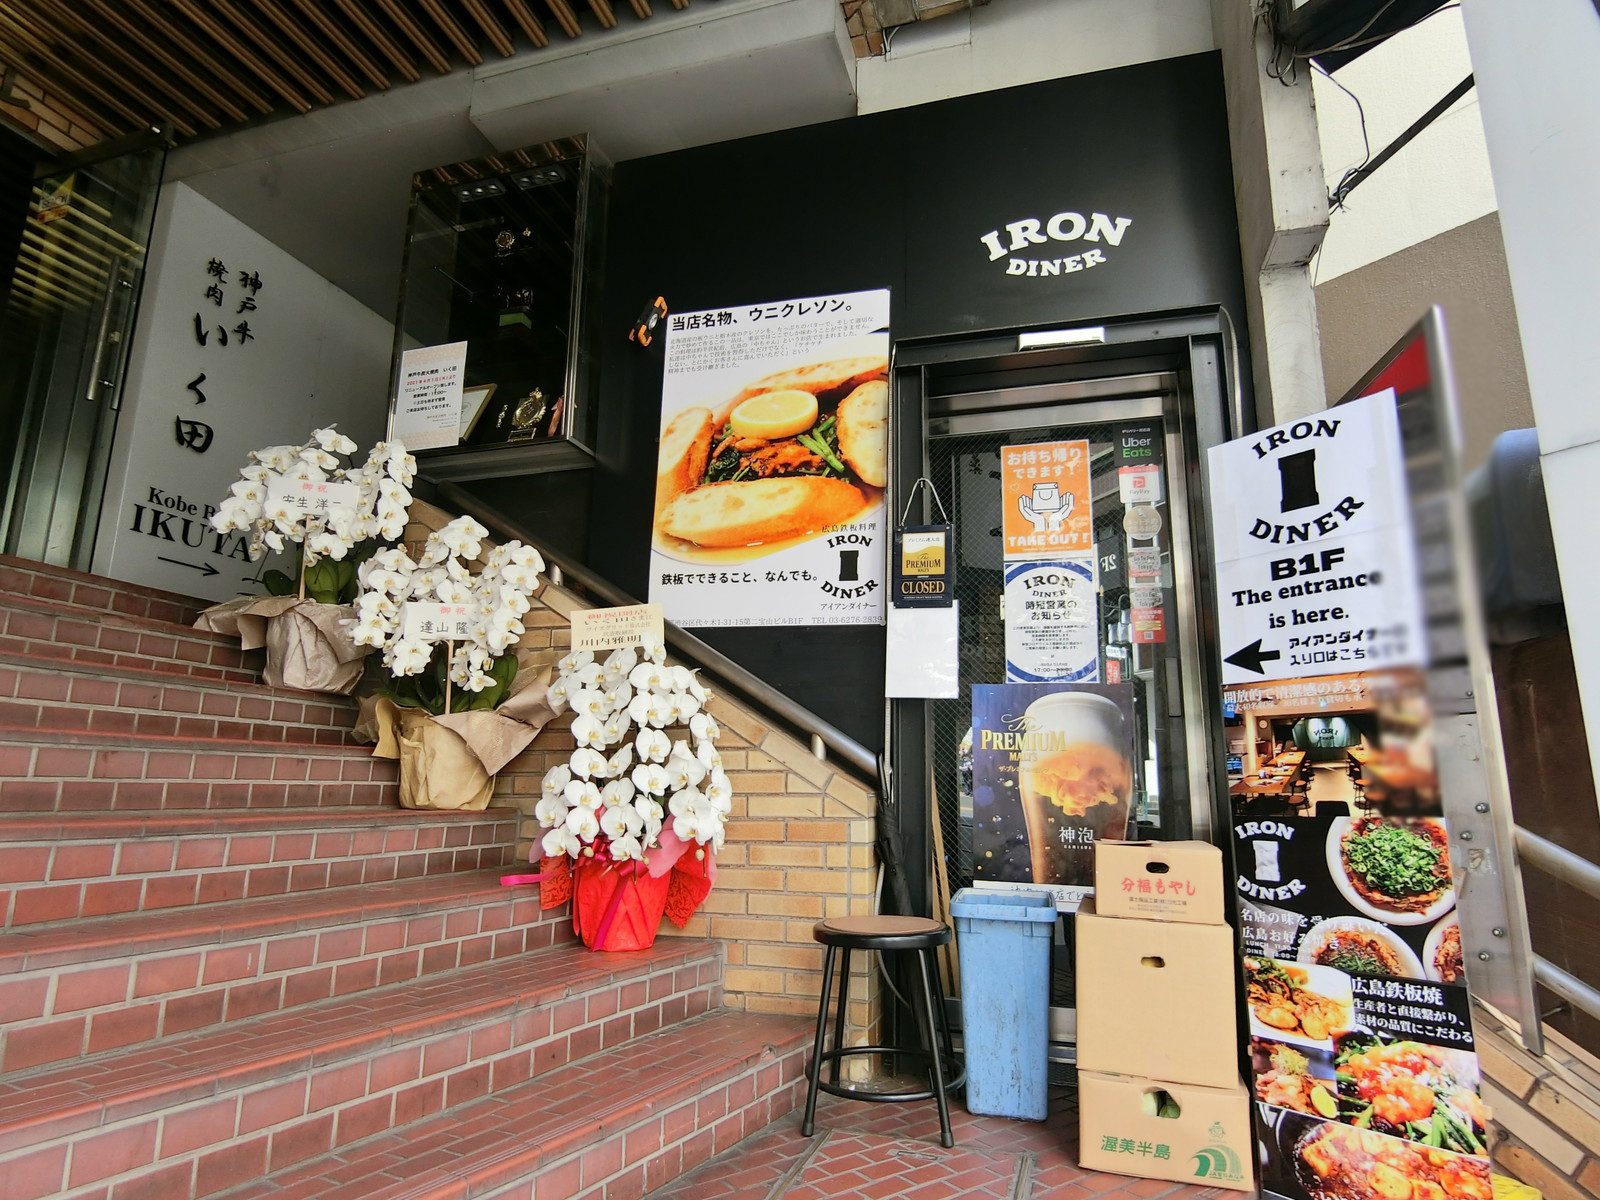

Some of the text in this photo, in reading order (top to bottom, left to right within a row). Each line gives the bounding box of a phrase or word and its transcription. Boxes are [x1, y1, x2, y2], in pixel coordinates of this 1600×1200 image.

[980, 212, 1133, 262] IRON
[1005, 248, 1107, 277] DINER
[206, 257, 229, 307] 焼肉
[234, 271, 263, 345] 神戸牛
[671, 299, 853, 332] 当店名物、ウニクレソン。
[1121, 437, 1152, 448] Uber
[1251, 419, 1341, 460] IRON
[1007, 447, 1082, 466] お持ち帰り
[1122, 447, 1152, 458] Eats
[148, 486, 198, 516] Kobe
[821, 522, 877, 533] 広島鉄板料理
[1248, 496, 1365, 545] DINER
[130, 503, 253, 563] IKUTA
[826, 534, 873, 549] IRON
[1008, 534, 1046, 547] TAKE
[905, 559, 941, 569] PREMIUM
[1270, 547, 1345, 581] B1F
[661, 570, 818, 586] 鉄板でできること、なんでも。
[901, 581, 945, 594] CLOSED
[1023, 574, 1077, 590] IRON
[1232, 570, 1383, 606] The entrance
[820, 579, 879, 599] DINER
[1032, 589, 1068, 598] DINER
[820, 602, 878, 611] アイアンダイナー
[1025, 600, 1078, 610] 時短営業の
[812, 616, 828, 624] TEL
[1031, 610, 1072, 621] お知らせ
[1268, 606, 1350, 629] is here.
[1001, 713, 1043, 731] The
[981, 729, 1068, 752] PREMIUM
[1058, 826, 1094, 843] 神泡
[1234, 820, 1296, 840] IRON
[1121, 877, 1197, 896] 分福もやし
[1236, 875, 1307, 900] DINER
[1350, 976, 1444, 1007] 広島鉄板焼
[1355, 1013, 1474, 1044] 素材の品質にこだわる
[1100, 1135, 1171, 1161] 渥美半島
